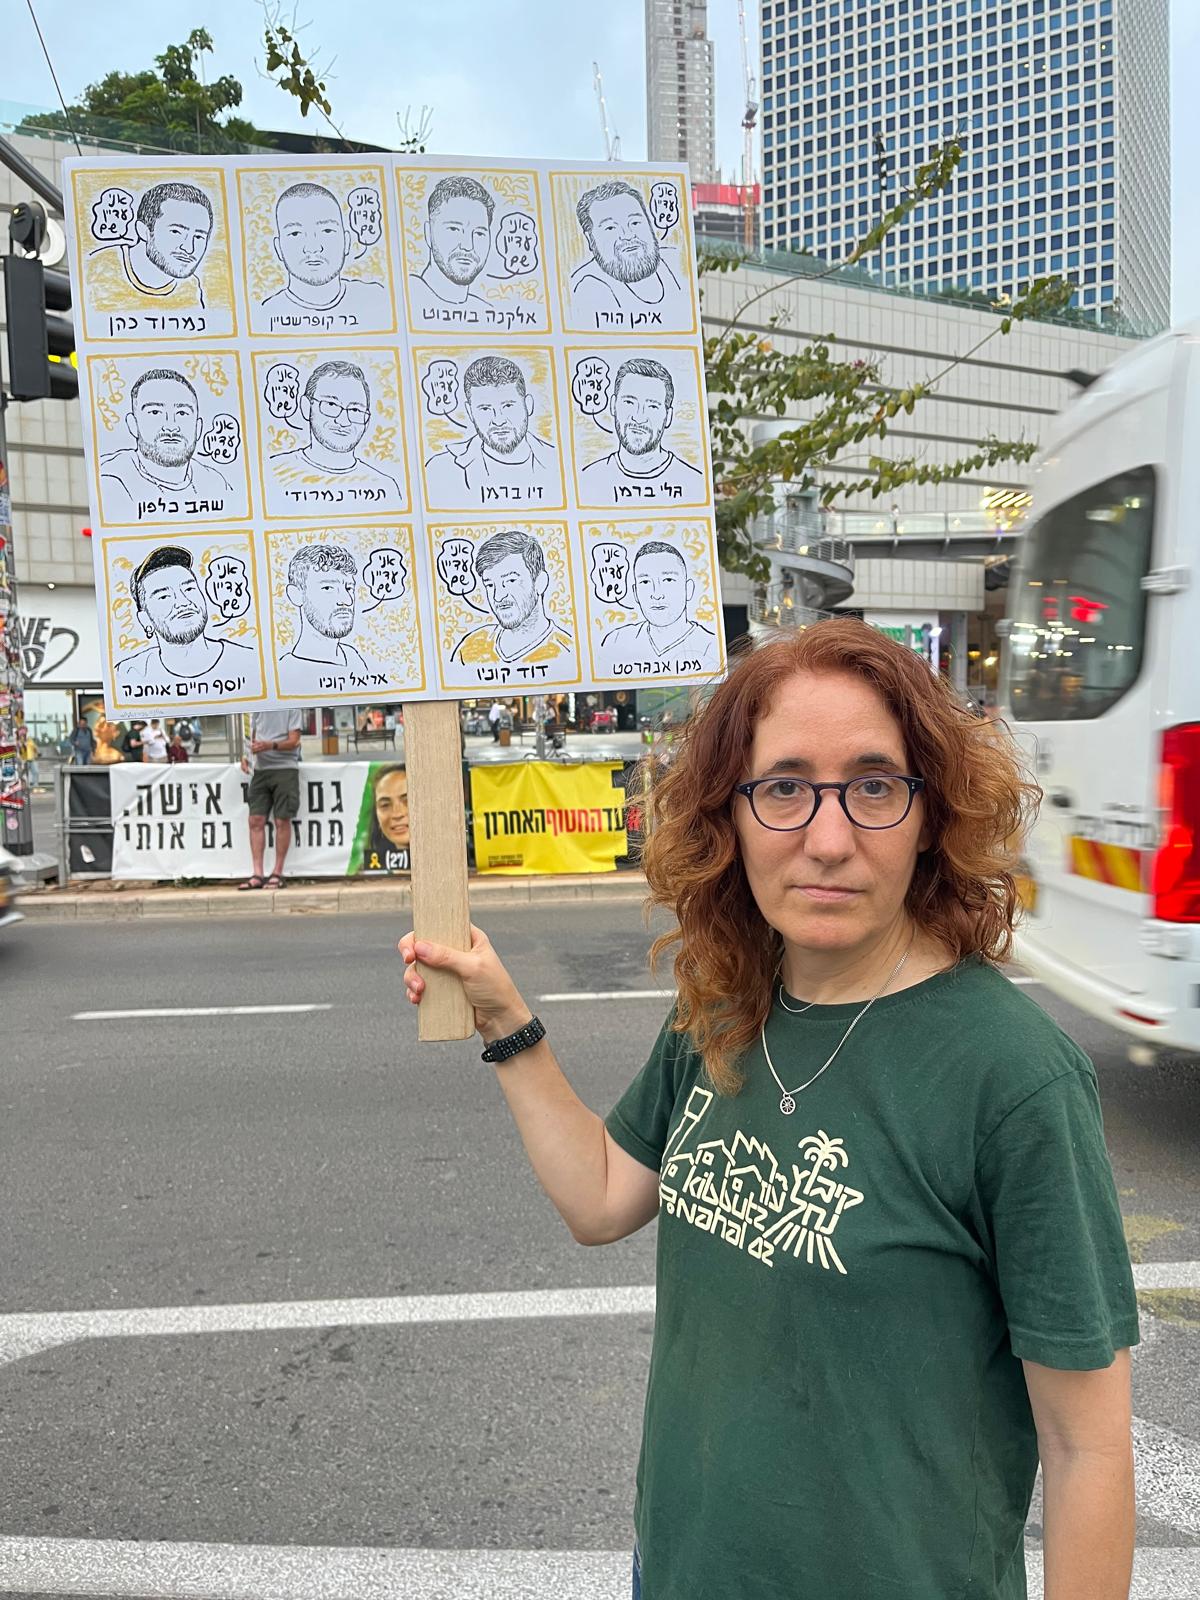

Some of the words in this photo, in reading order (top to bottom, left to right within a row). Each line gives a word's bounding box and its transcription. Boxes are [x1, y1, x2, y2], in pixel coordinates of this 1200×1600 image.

[657, 185, 675, 198] אני
[108, 193, 128, 208] אני
[356, 193, 375, 207] אני
[653, 199, 675, 214] עדיין
[102, 208, 128, 223] עדיין
[353, 209, 377, 225] עדיין
[658, 212, 674, 223] שם
[99, 222, 118, 235] שם
[360, 224, 376, 237] שם
[508, 218, 529, 234] אני
[503, 235, 533, 254] עדיין
[510, 254, 530, 268] שם
[270, 315, 334, 332] קופרשטיין
[338, 315, 359, 326] בר
[422, 308, 479, 323] בוחבוט
[485, 305, 537, 330] אלקנה
[595, 311, 624, 329] הורן
[630, 311, 663, 329] איתן
[109, 316, 138, 337] כהן
[146, 316, 206, 332] נמרוד
[276, 368, 293, 382] אני
[438, 368, 454, 379] אני
[584, 363, 603, 378] אני
[271, 385, 296, 401] עדיין
[430, 380, 454, 398] עדיין
[577, 378, 604, 397] עדיין
[276, 400, 293, 412] שם
[435, 393, 451, 407] שם
[585, 392, 601, 407] שם
[215, 419, 235, 434] אני
[206, 435, 236, 451] עדיין
[213, 448, 232, 459] שם
[285, 489, 344, 502] נמרודי
[347, 488, 386, 502] תמיר
[480, 485, 522, 504] ברמן
[527, 486, 544, 499] זיו
[613, 485, 656, 503] ברמן
[660, 481, 683, 499] גלי
[138, 497, 179, 520] כלפון
[184, 499, 224, 514] שגב
[450, 543, 469, 555] אני
[602, 548, 620, 564] אני
[378, 554, 396, 569] אני
[440, 558, 469, 575] עדיין
[217, 562, 238, 580] אני
[370, 570, 399, 587] עדיין
[598, 564, 625, 582] עדיין
[376, 582, 392, 595] שם
[450, 574, 470, 588] שם
[212, 580, 243, 601] עדיין
[606, 583, 623, 598] שם
[223, 598, 240, 611] שם
[516, 664, 549, 679] דוד
[613, 660, 672, 675] אנגרסט
[675, 659, 702, 675] מתן
[349, 671, 389, 687] אריאל
[476, 667, 511, 684] קוניו
[121, 684, 171, 698] אוחנה
[175, 681, 209, 697] חיים
[216, 676, 246, 695] יוסף
[319, 676, 346, 692] קוניו
[308, 781, 344, 813] גם
[123, 821, 185, 850] אותי
[202, 821, 233, 849] גם
[385, 850, 408, 870] (27)
